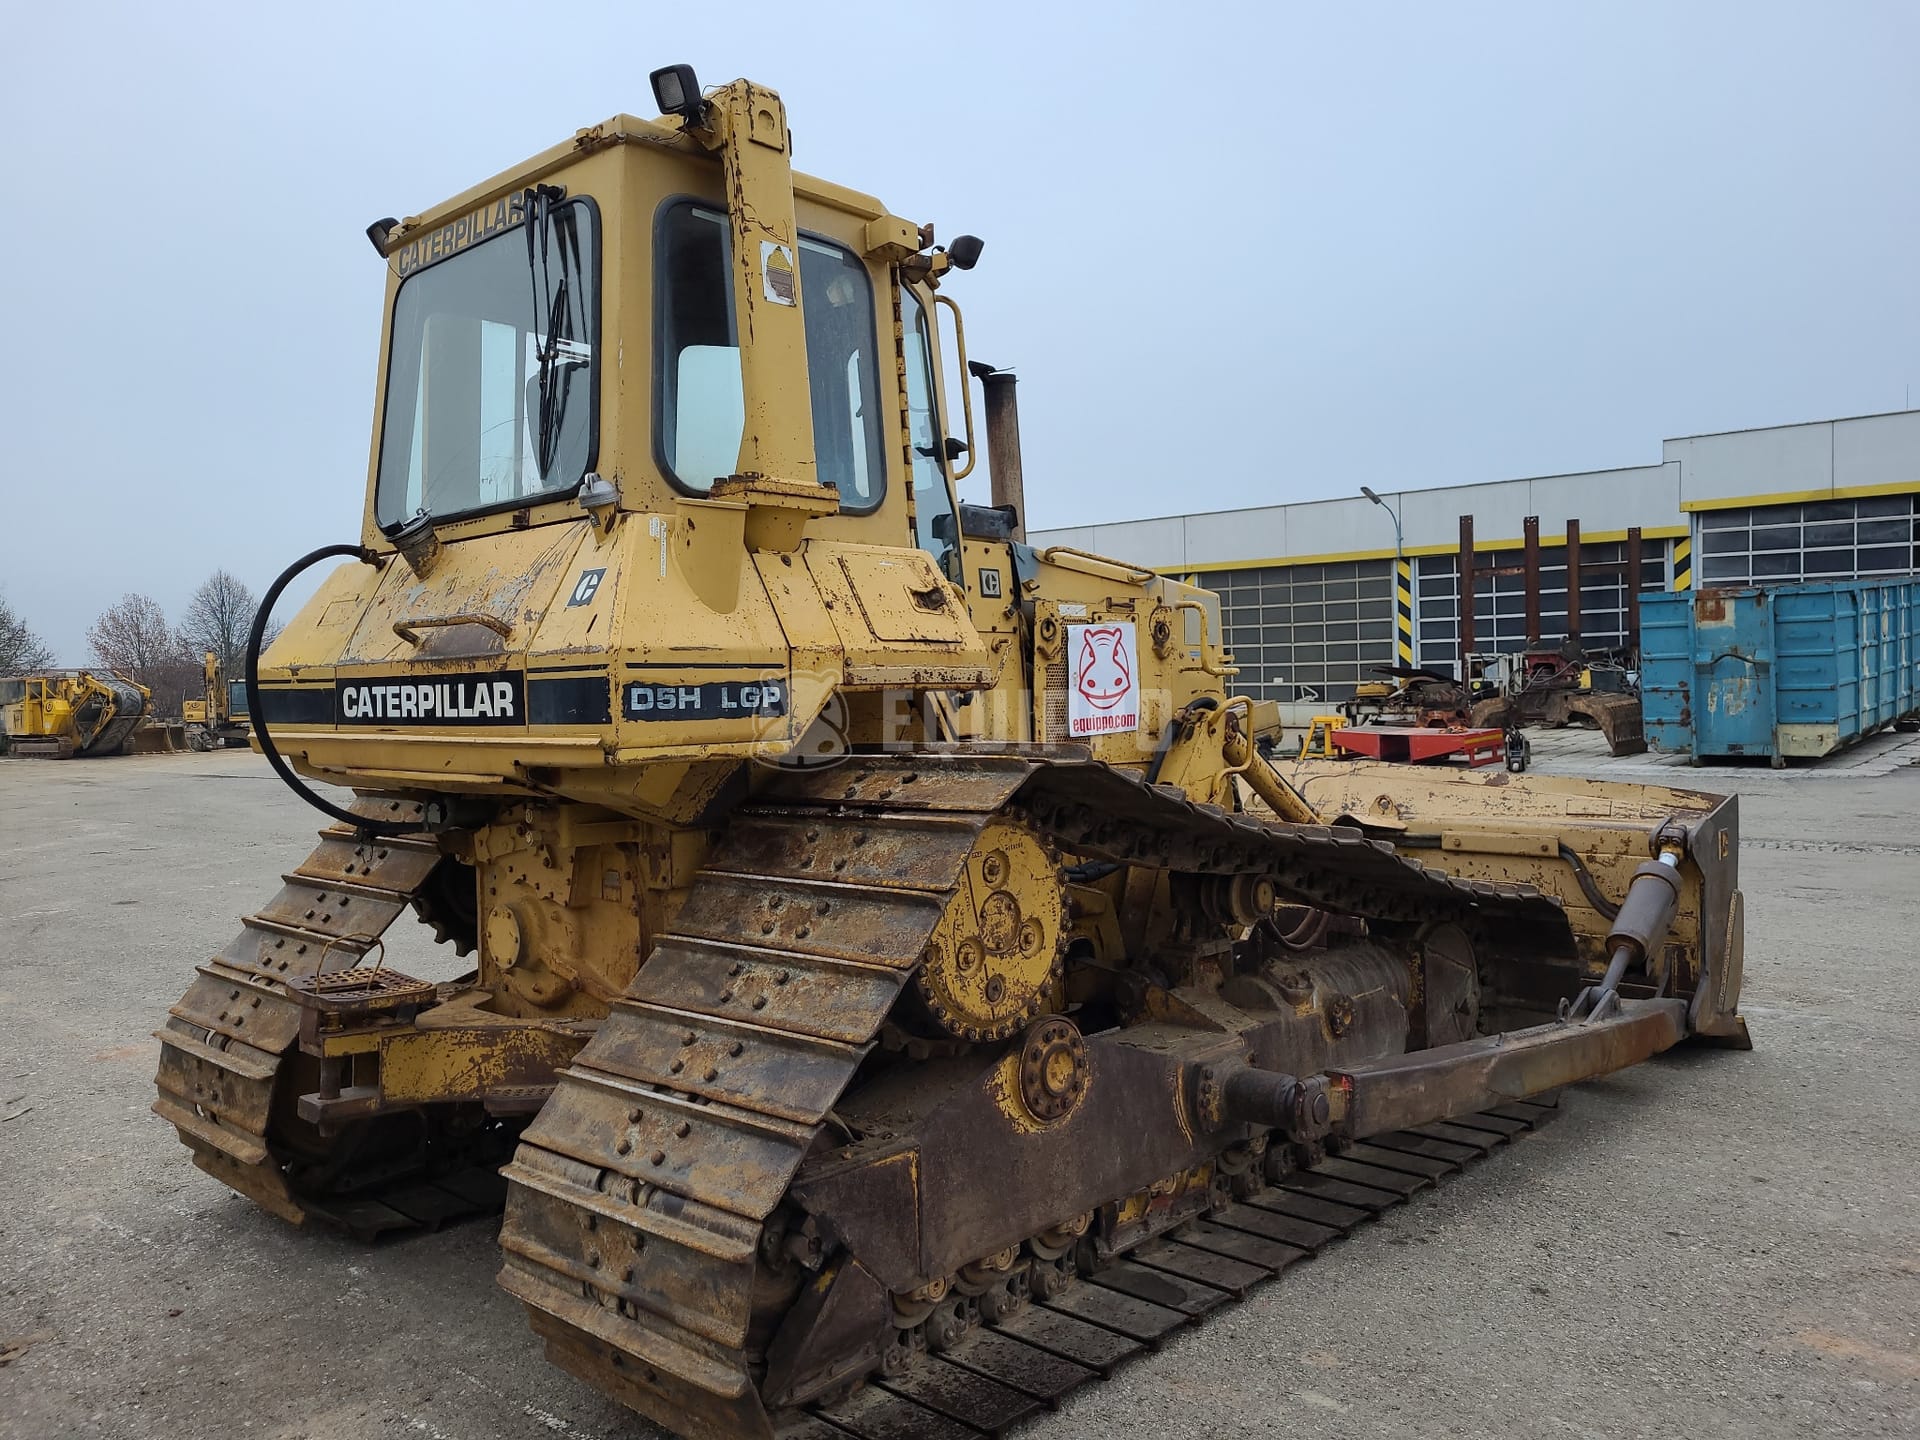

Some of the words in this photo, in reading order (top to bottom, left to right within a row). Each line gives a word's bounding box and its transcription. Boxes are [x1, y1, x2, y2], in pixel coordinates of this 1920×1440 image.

[399, 191, 524, 275] CATERPILLAR
[342, 681, 514, 718] CATERPILLAR
[630, 687, 701, 711] D5H
[721, 686, 781, 709] LGP
[1073, 713, 1136, 733] equippo.com
